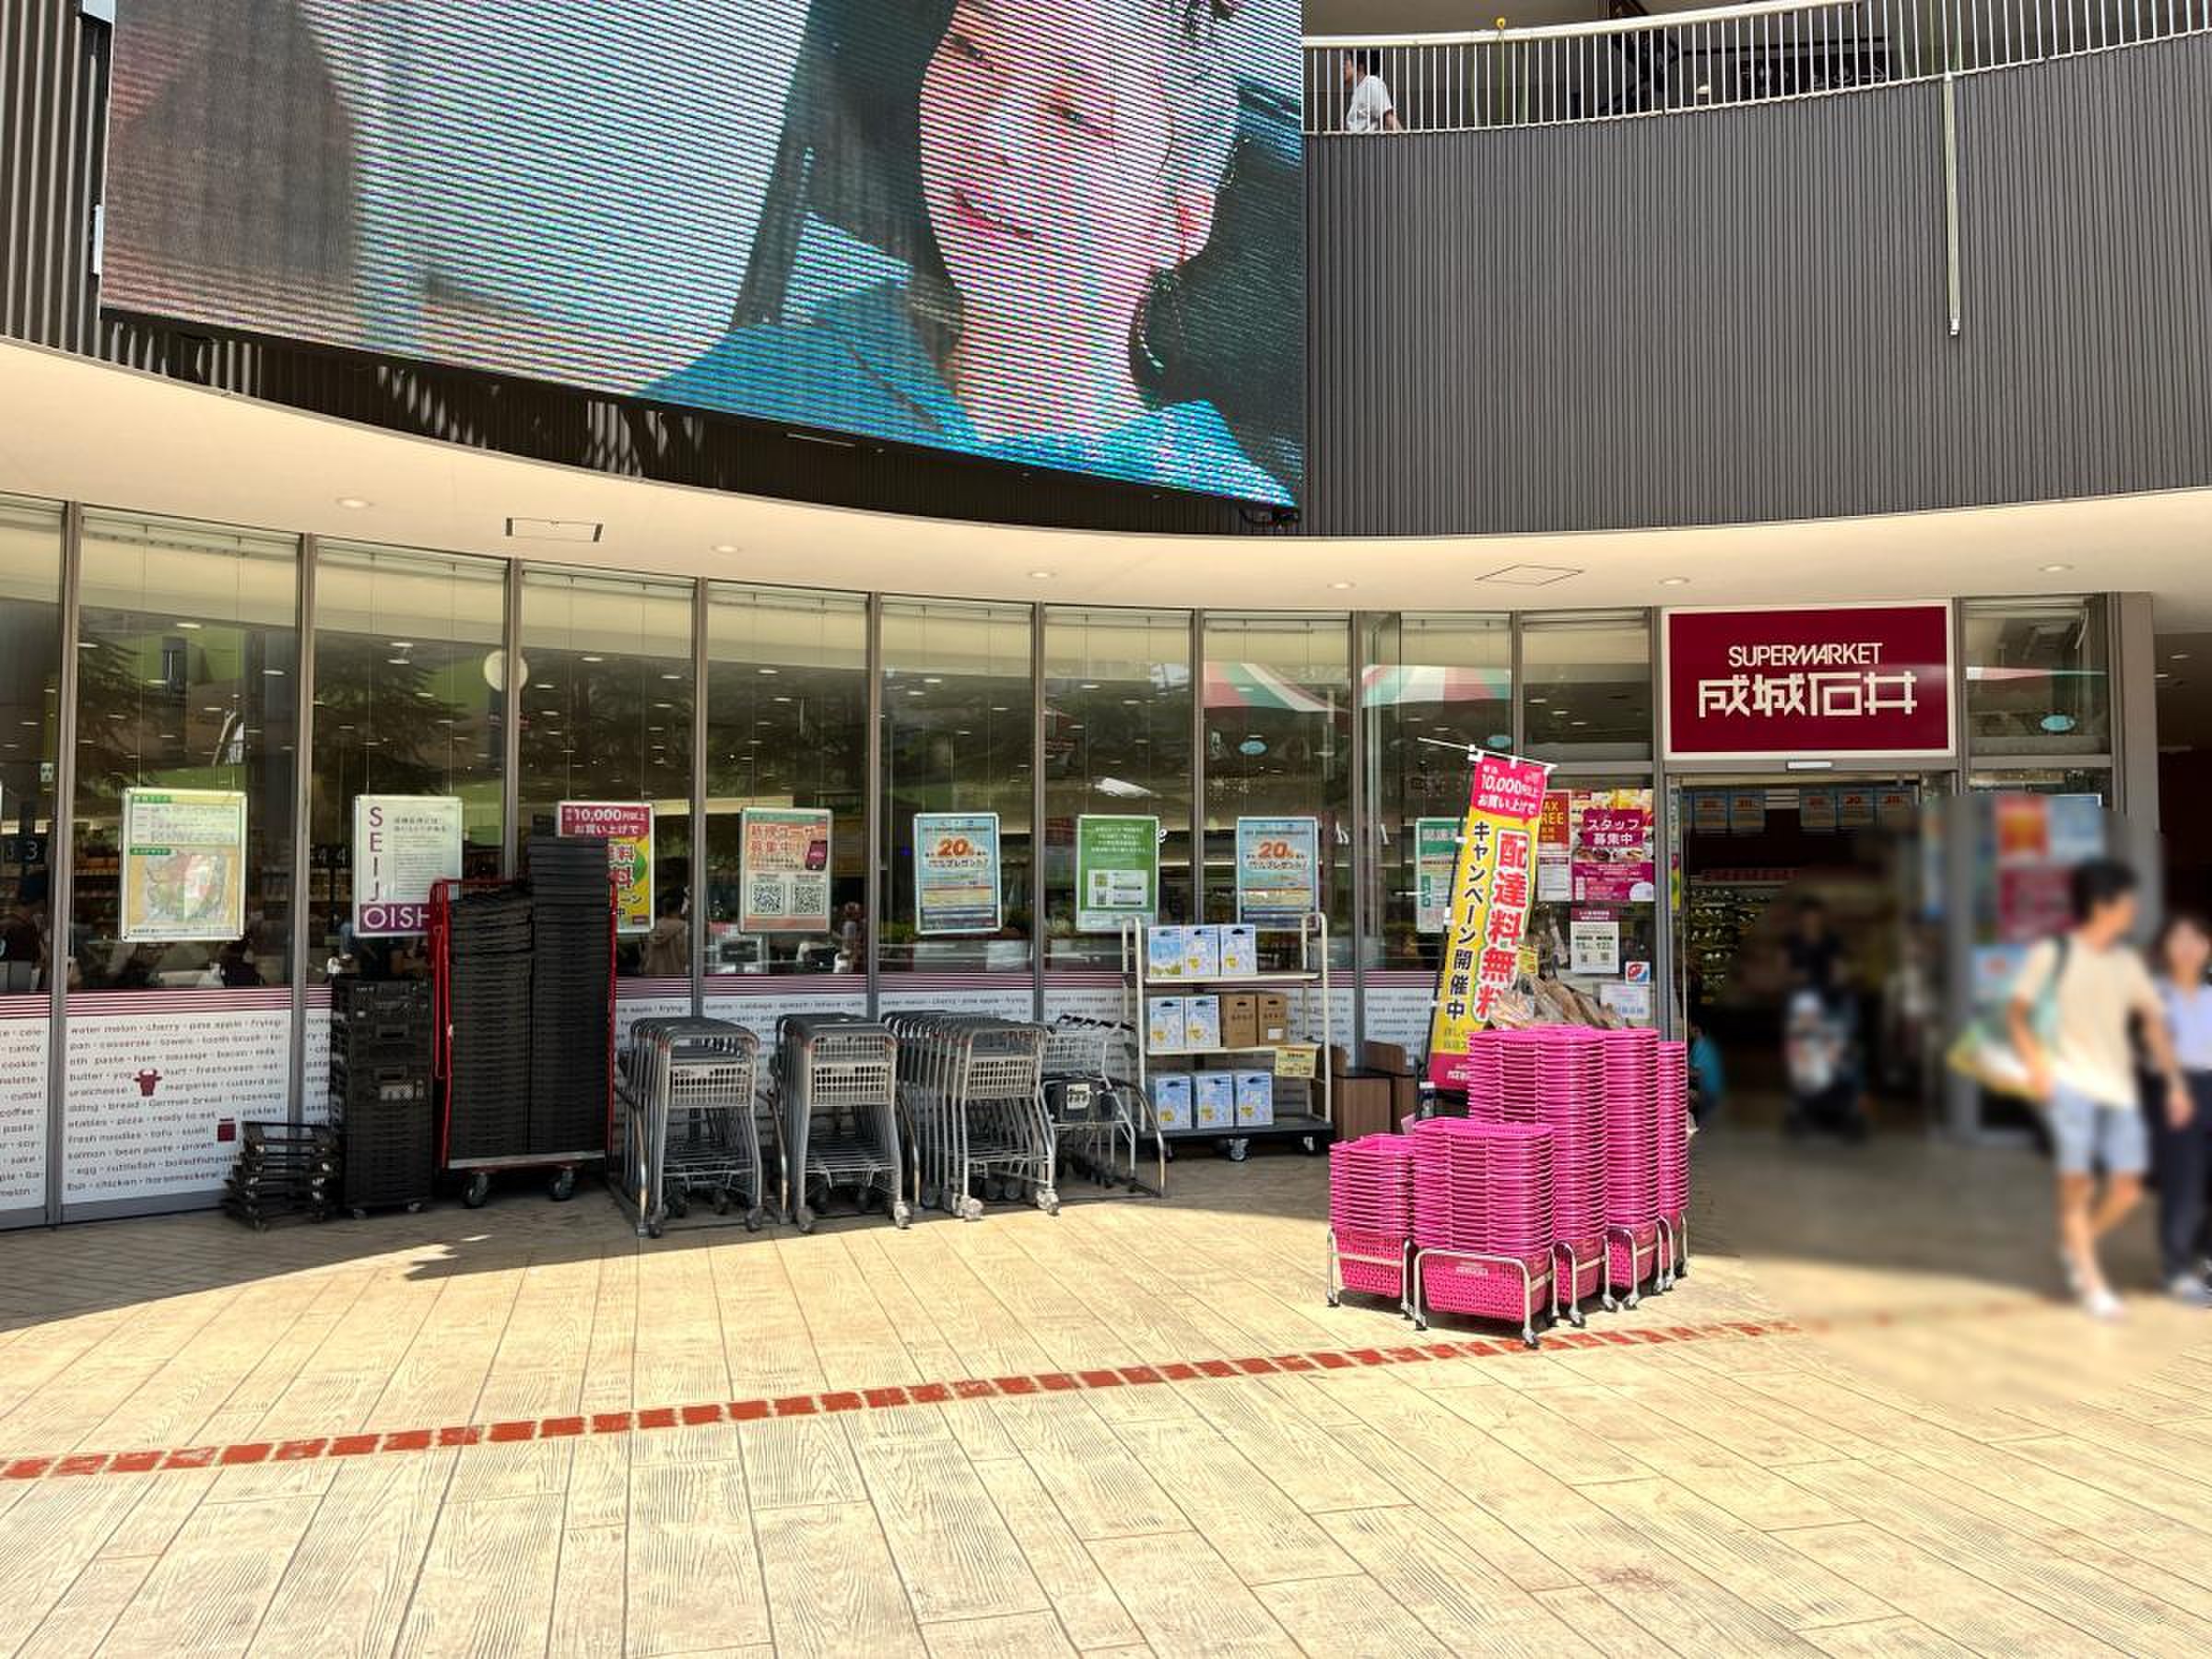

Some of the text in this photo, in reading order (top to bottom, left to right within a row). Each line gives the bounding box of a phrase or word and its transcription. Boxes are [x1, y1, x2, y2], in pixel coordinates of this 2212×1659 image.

[1727, 641, 1883, 667] SUPERMARKET
[1698, 670, 1918, 718] 成城石井
[1477, 794, 1536, 816] お買い上げで
[1544, 799, 1559, 812] AX
[1540, 812, 1564, 826] REE
[1587, 818, 1640, 830] スタッフ
[1593, 832, 1633, 845] 募集中
[1446, 821, 1490, 1020] キャンペーン開催中
